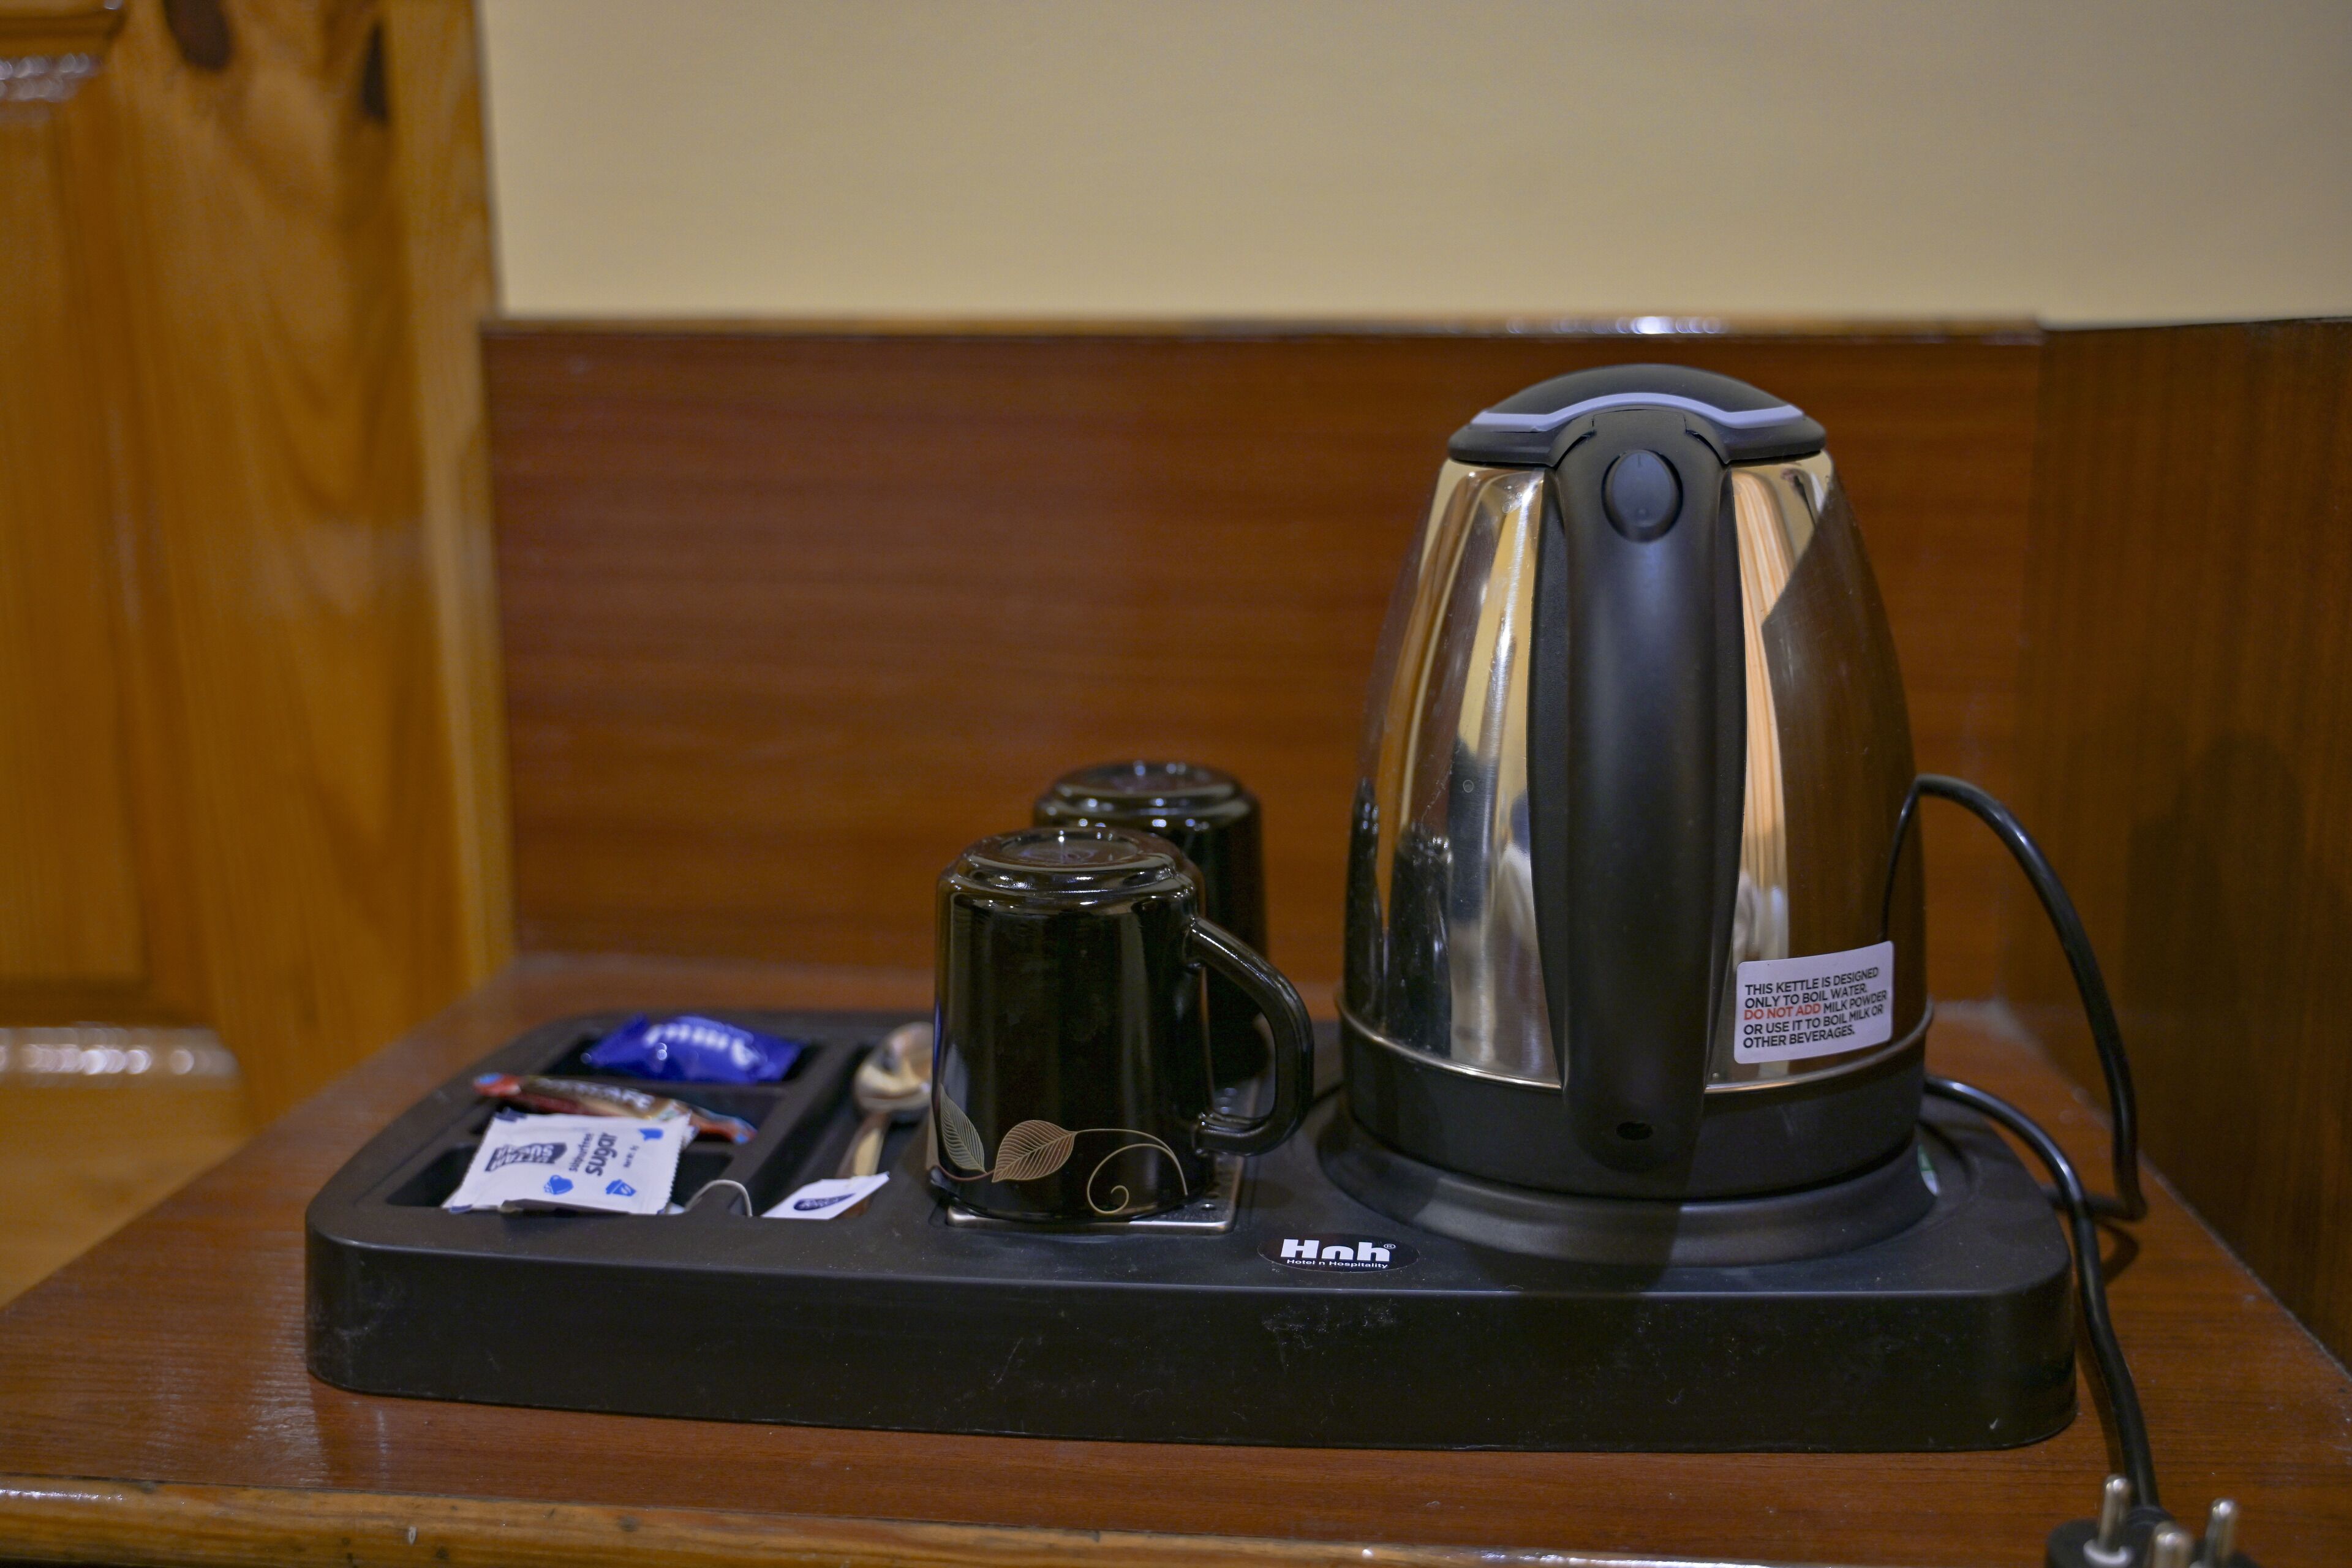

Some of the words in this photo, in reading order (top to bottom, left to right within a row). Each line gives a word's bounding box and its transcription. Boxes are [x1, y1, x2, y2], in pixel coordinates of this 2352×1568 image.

[1745, 983, 1773, 995] THIS
[1776, 978, 1819, 993] KETTLE
[1822, 977, 1830, 987] IS
[1833, 967, 1879, 986] DESIGNED
[1744, 997, 1781, 1008] ONLY
[1784, 994, 1800, 1006] TO
[1803, 992, 1828, 1003] BOIL
[1831, 984, 1867, 999] WATER.
[1744, 1009, 1763, 1020] DO
[1767, 1007, 1793, 1019] NOT
[1796, 1003, 1821, 1016] ADD
[1823, 1000, 1847, 1013] MILK
[1849, 990, 1887, 1008] POWDER
[1744, 1024, 1762, 1035] OR
[1766, 1022, 1789, 1033] USE
[1792, 1020, 1804, 1031] IT
[1807, 1018, 1820, 1030] TO
[1823, 1014, 1846, 1027] BOIL
[1849, 1009, 1870, 1022] MILK
[1871, 1004, 1883, 1016] OR
[1743, 1035, 1786, 1048] OTHER
[1789, 1025, 1855, 1044] BEVERAGES.
[585, 1132, 617, 1176] sugar
